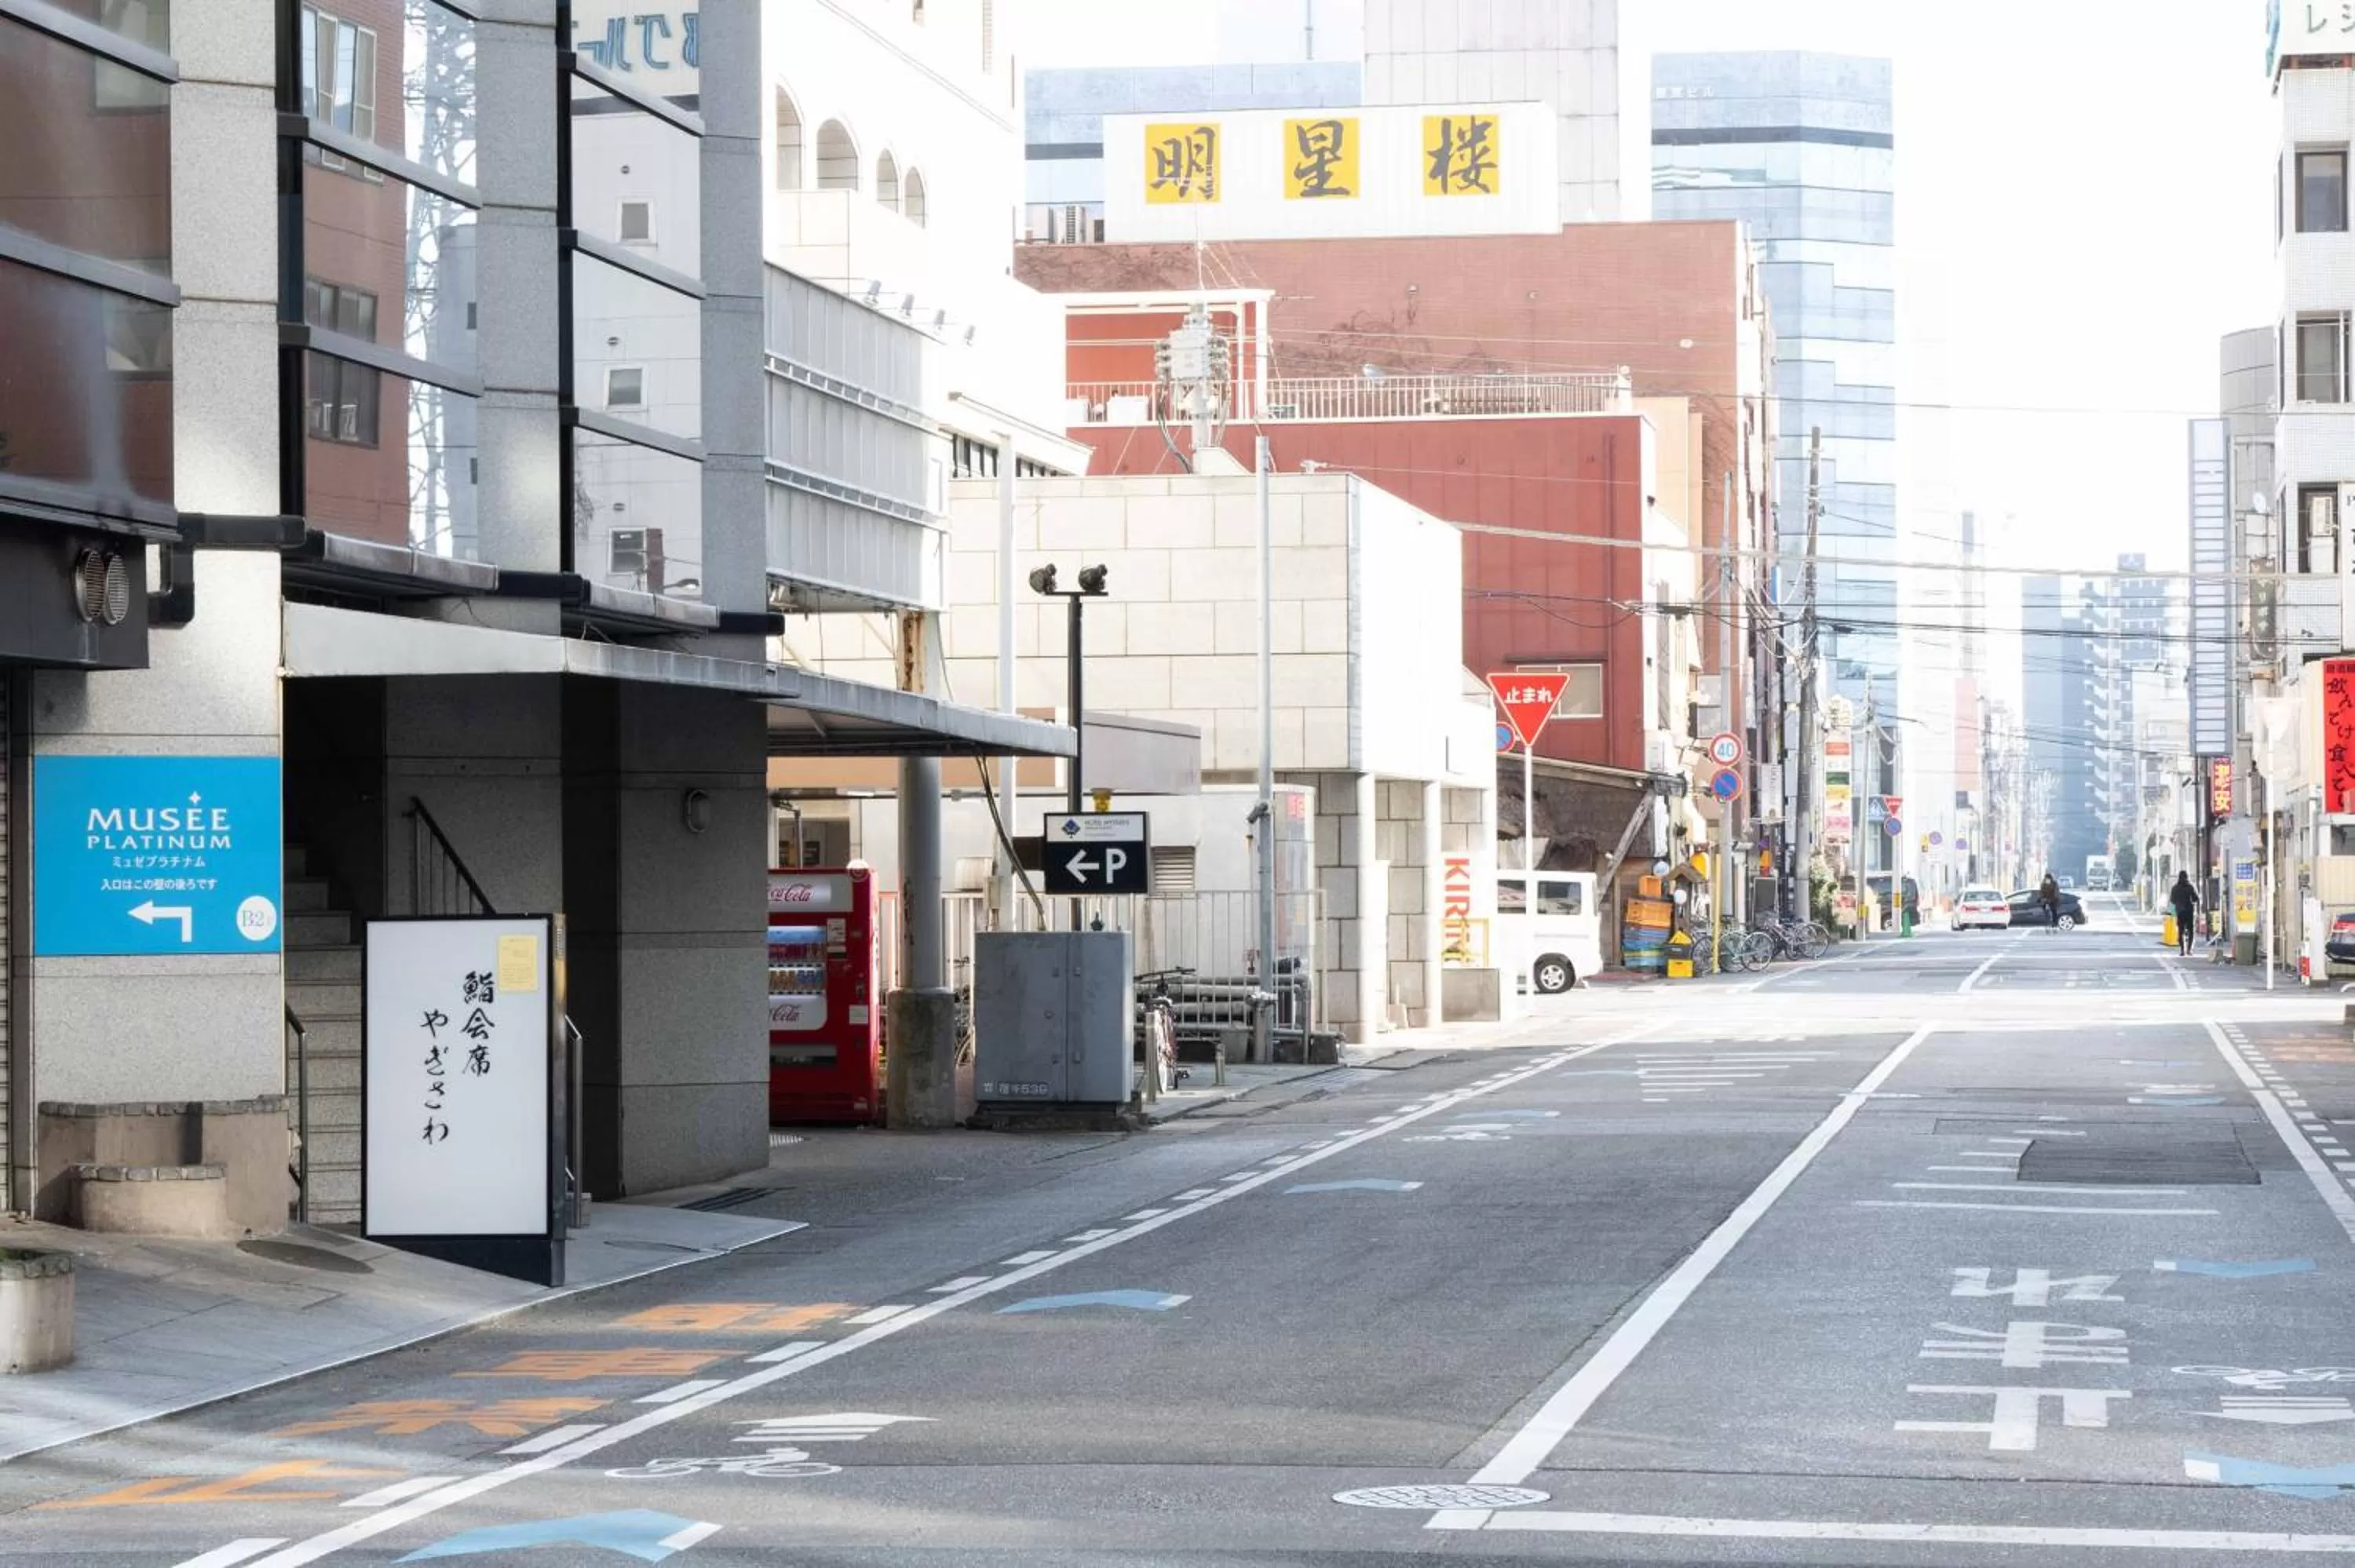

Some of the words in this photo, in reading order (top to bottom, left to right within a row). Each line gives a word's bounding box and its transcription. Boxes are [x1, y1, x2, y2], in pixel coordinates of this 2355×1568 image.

[1504, 686, 1554, 703] 止まれ
[1717, 742, 1735, 757] 40
[87, 835, 232, 850] PLATINUM
[112, 855, 206, 869] ミュゼプラチナム
[1105, 848, 1127, 884] P
[100, 878, 217, 891] 入口はこの壁の後ろです
[460, 971, 495, 1077] 鮨会席
[420, 1008, 450, 1145] やぎさわ
